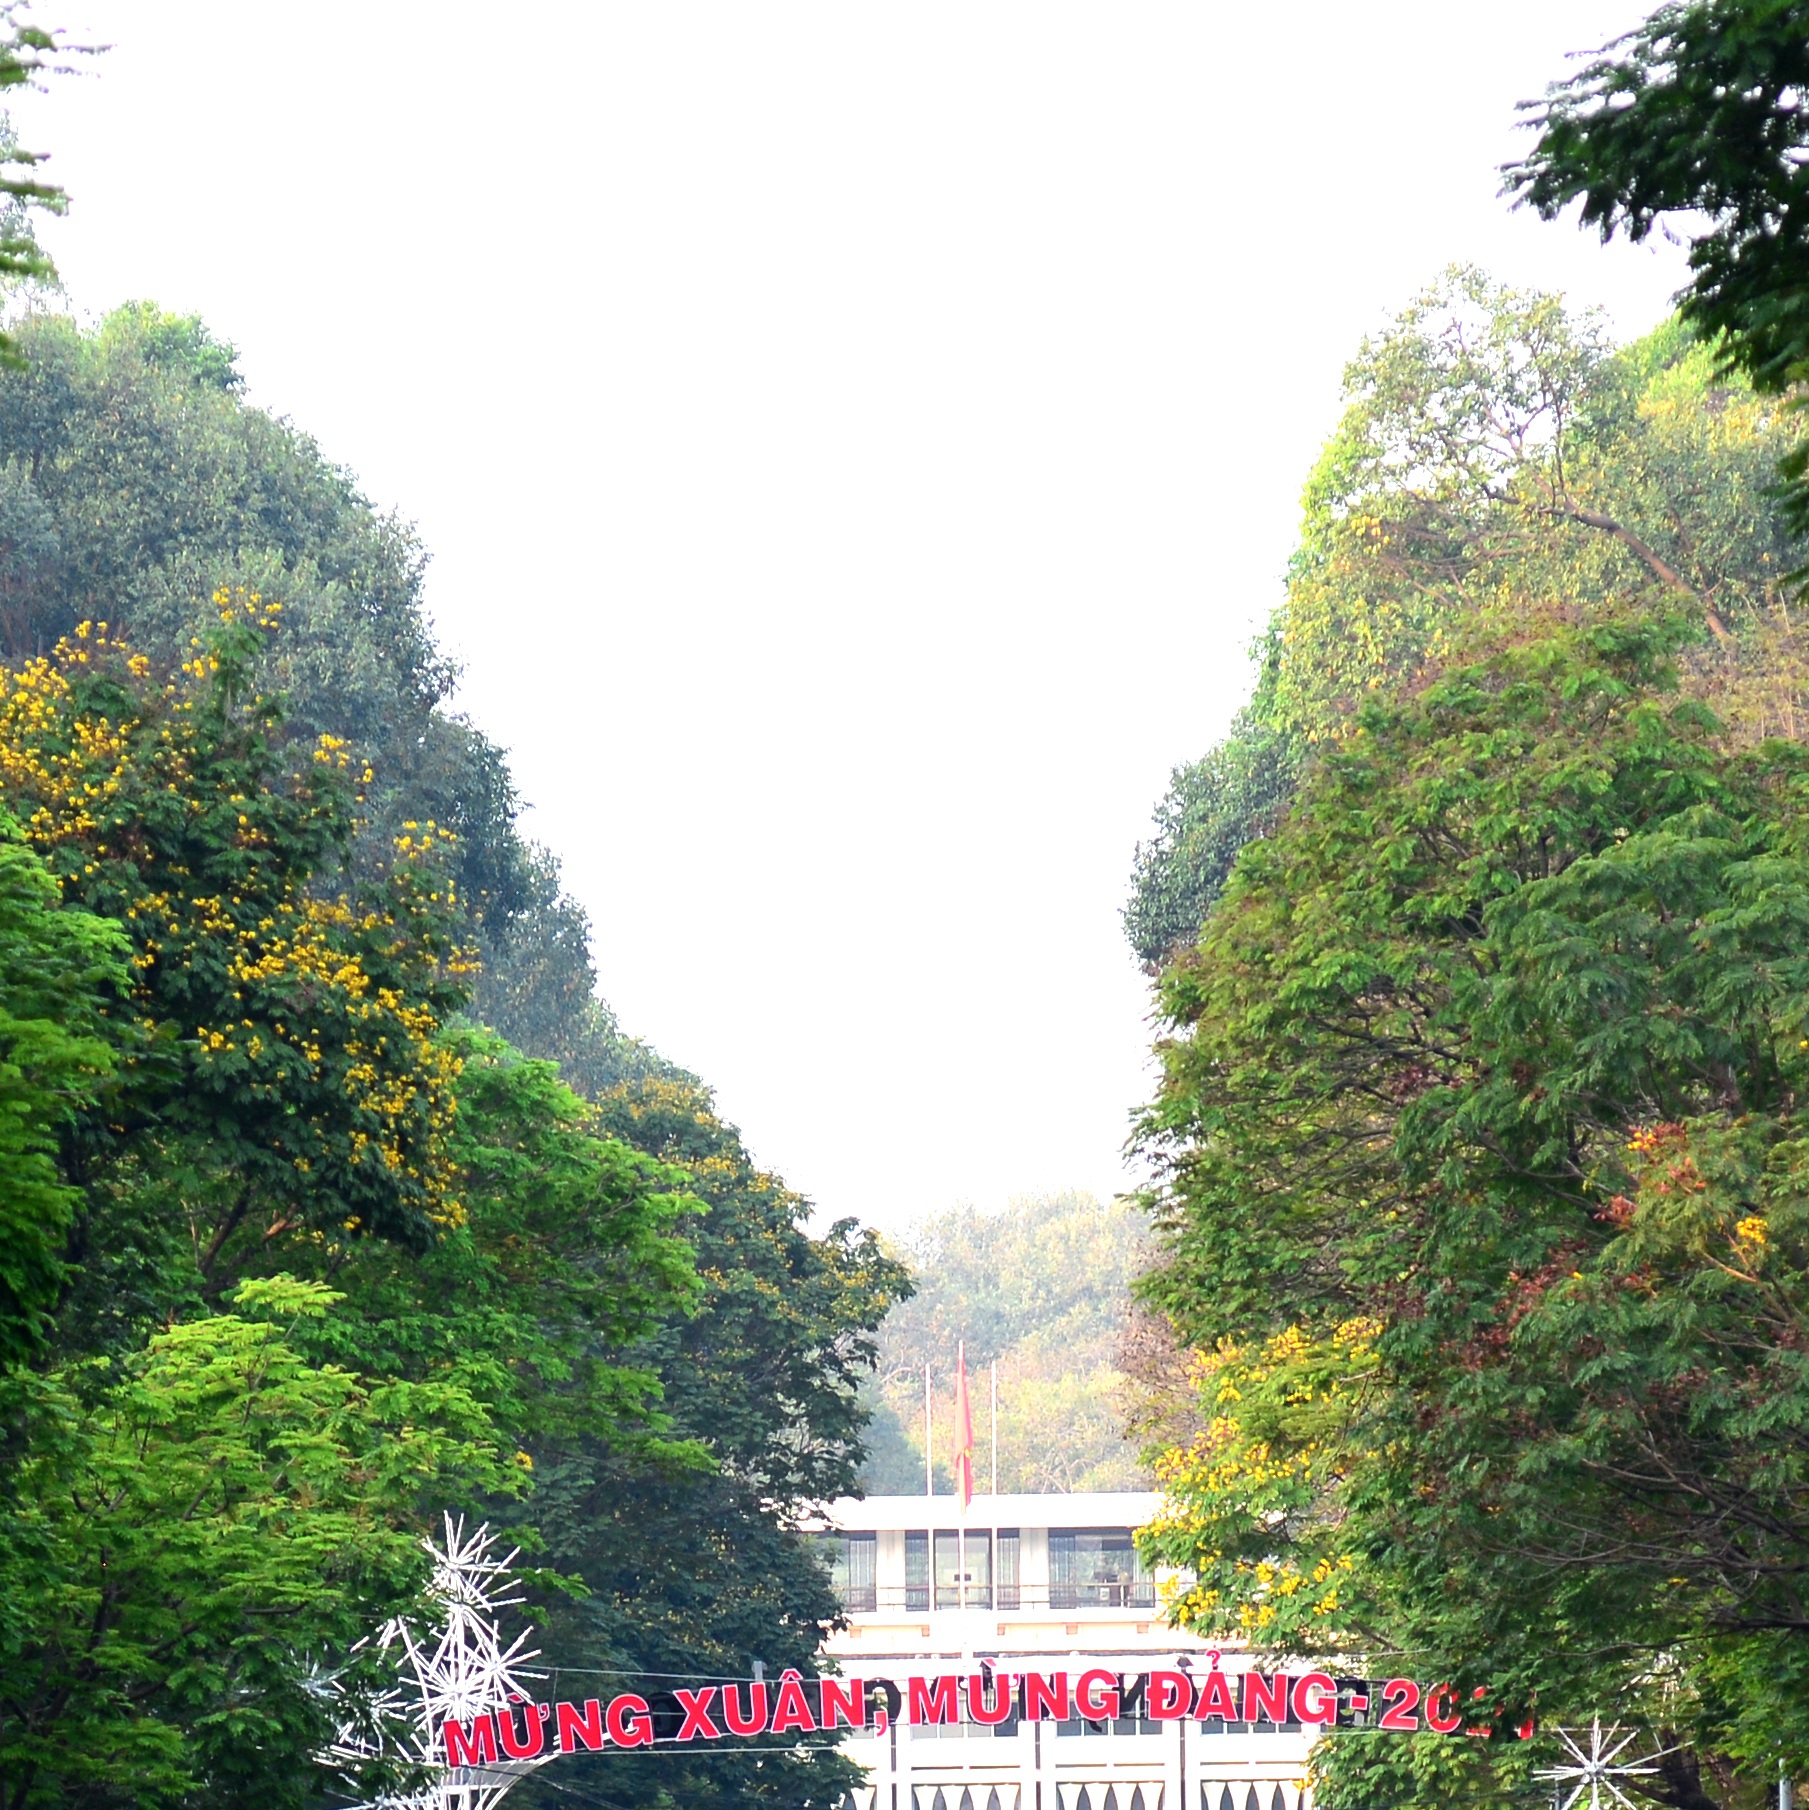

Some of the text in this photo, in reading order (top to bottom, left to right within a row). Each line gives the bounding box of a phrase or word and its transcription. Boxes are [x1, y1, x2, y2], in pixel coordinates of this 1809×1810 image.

[444, 1692, 654, 1769] MỪNG
[672, 1667, 888, 1740] XUÂN,
[909, 1657, 1120, 1724] MỪNG
